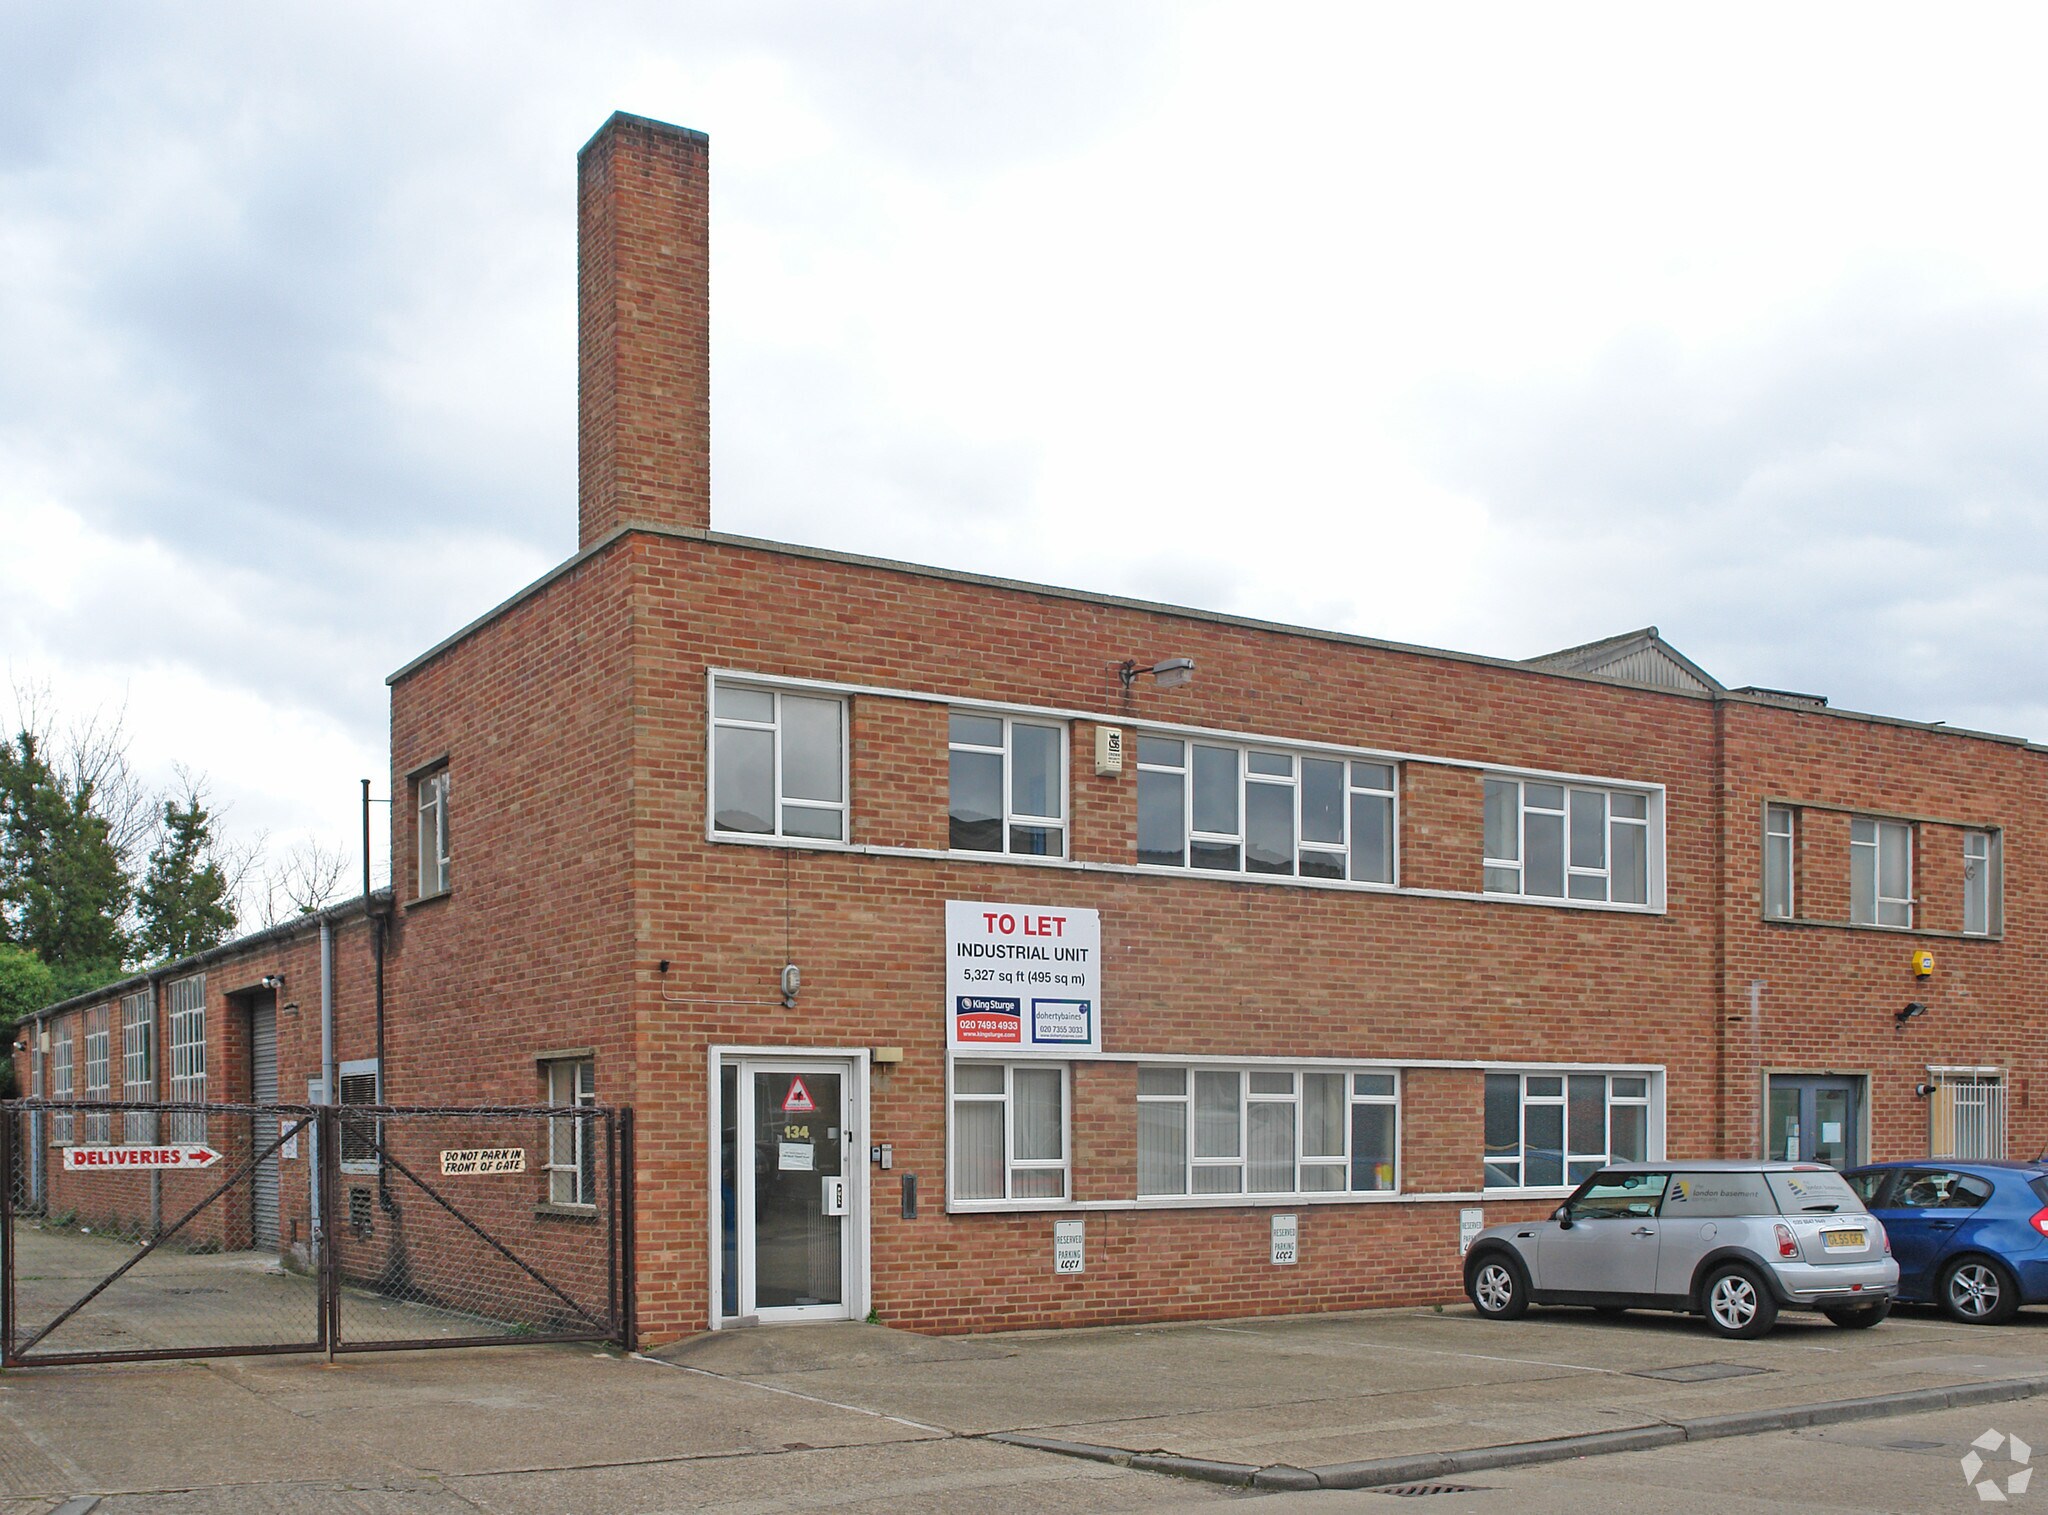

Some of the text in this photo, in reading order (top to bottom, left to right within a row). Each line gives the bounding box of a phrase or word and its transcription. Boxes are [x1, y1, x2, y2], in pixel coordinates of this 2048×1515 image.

[983, 913, 1067, 937] TO LET
[957, 943, 1089, 962] INDUSTRIAL UNIT
[963, 969, 1086, 986] 5,327 sq ft (495 sq m)
[972, 1000, 1015, 1012] King Sturge
[1036, 1011, 1082, 1021] dohertybaines
[960, 1020, 1018, 1030] 020 7493 4933
[1040, 1025, 1052, 1033] 020
[1052, 1025, 1068, 1033] 7355
[784, 1125, 810, 1139] 134
[73, 1149, 181, 1165] DELIVERIES
[445, 1149, 522, 1161] DO NOT PARK IN
[445, 1160, 521, 1172] FRONT OF GATE
[1693, 1189, 1759, 1198] london basement
[1057, 1234, 1082, 1244] RESERVED
[1058, 1250, 1081, 1259] PARKING
[1275, 1250, 1293, 1260] LCC2
